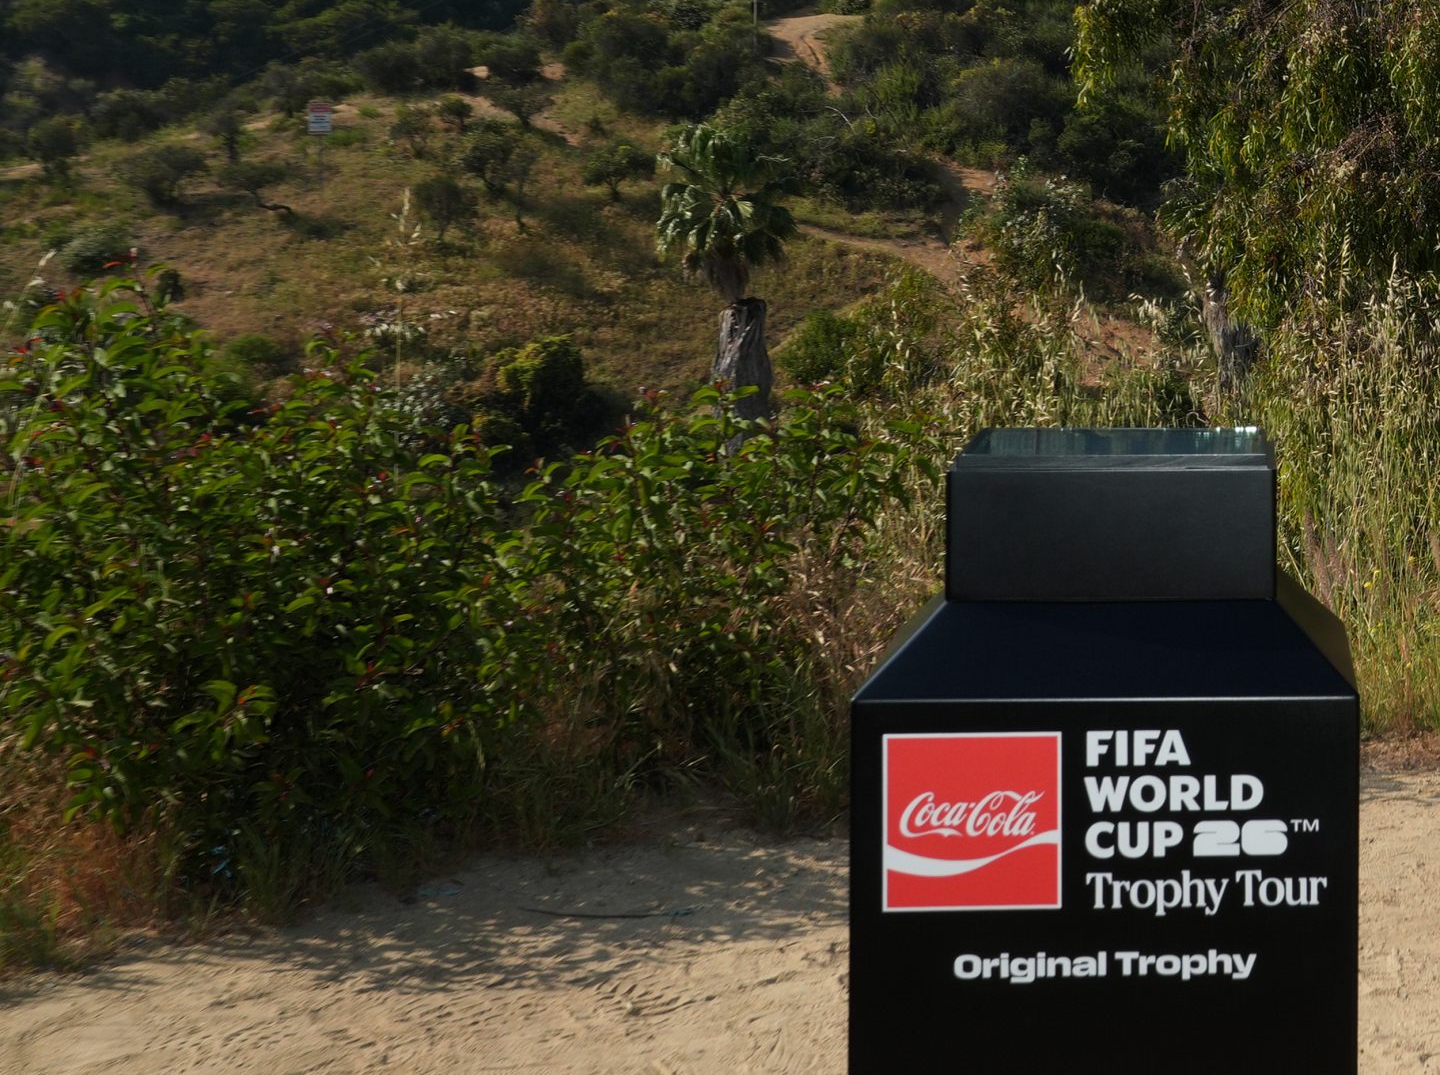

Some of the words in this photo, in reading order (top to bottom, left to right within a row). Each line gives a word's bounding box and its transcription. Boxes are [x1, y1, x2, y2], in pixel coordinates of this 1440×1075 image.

[1086, 729, 1191, 767] FIFA
[1083, 774, 1264, 813] WORLD
[899, 790, 1046, 838] Coca-Cola
[1085, 821, 1184, 859] CUP
[1085, 869, 1229, 916] Trophy
[1235, 869, 1328, 906] Tour
[953, 951, 1107, 984] Original
[1114, 949, 1257, 981] Trophy
